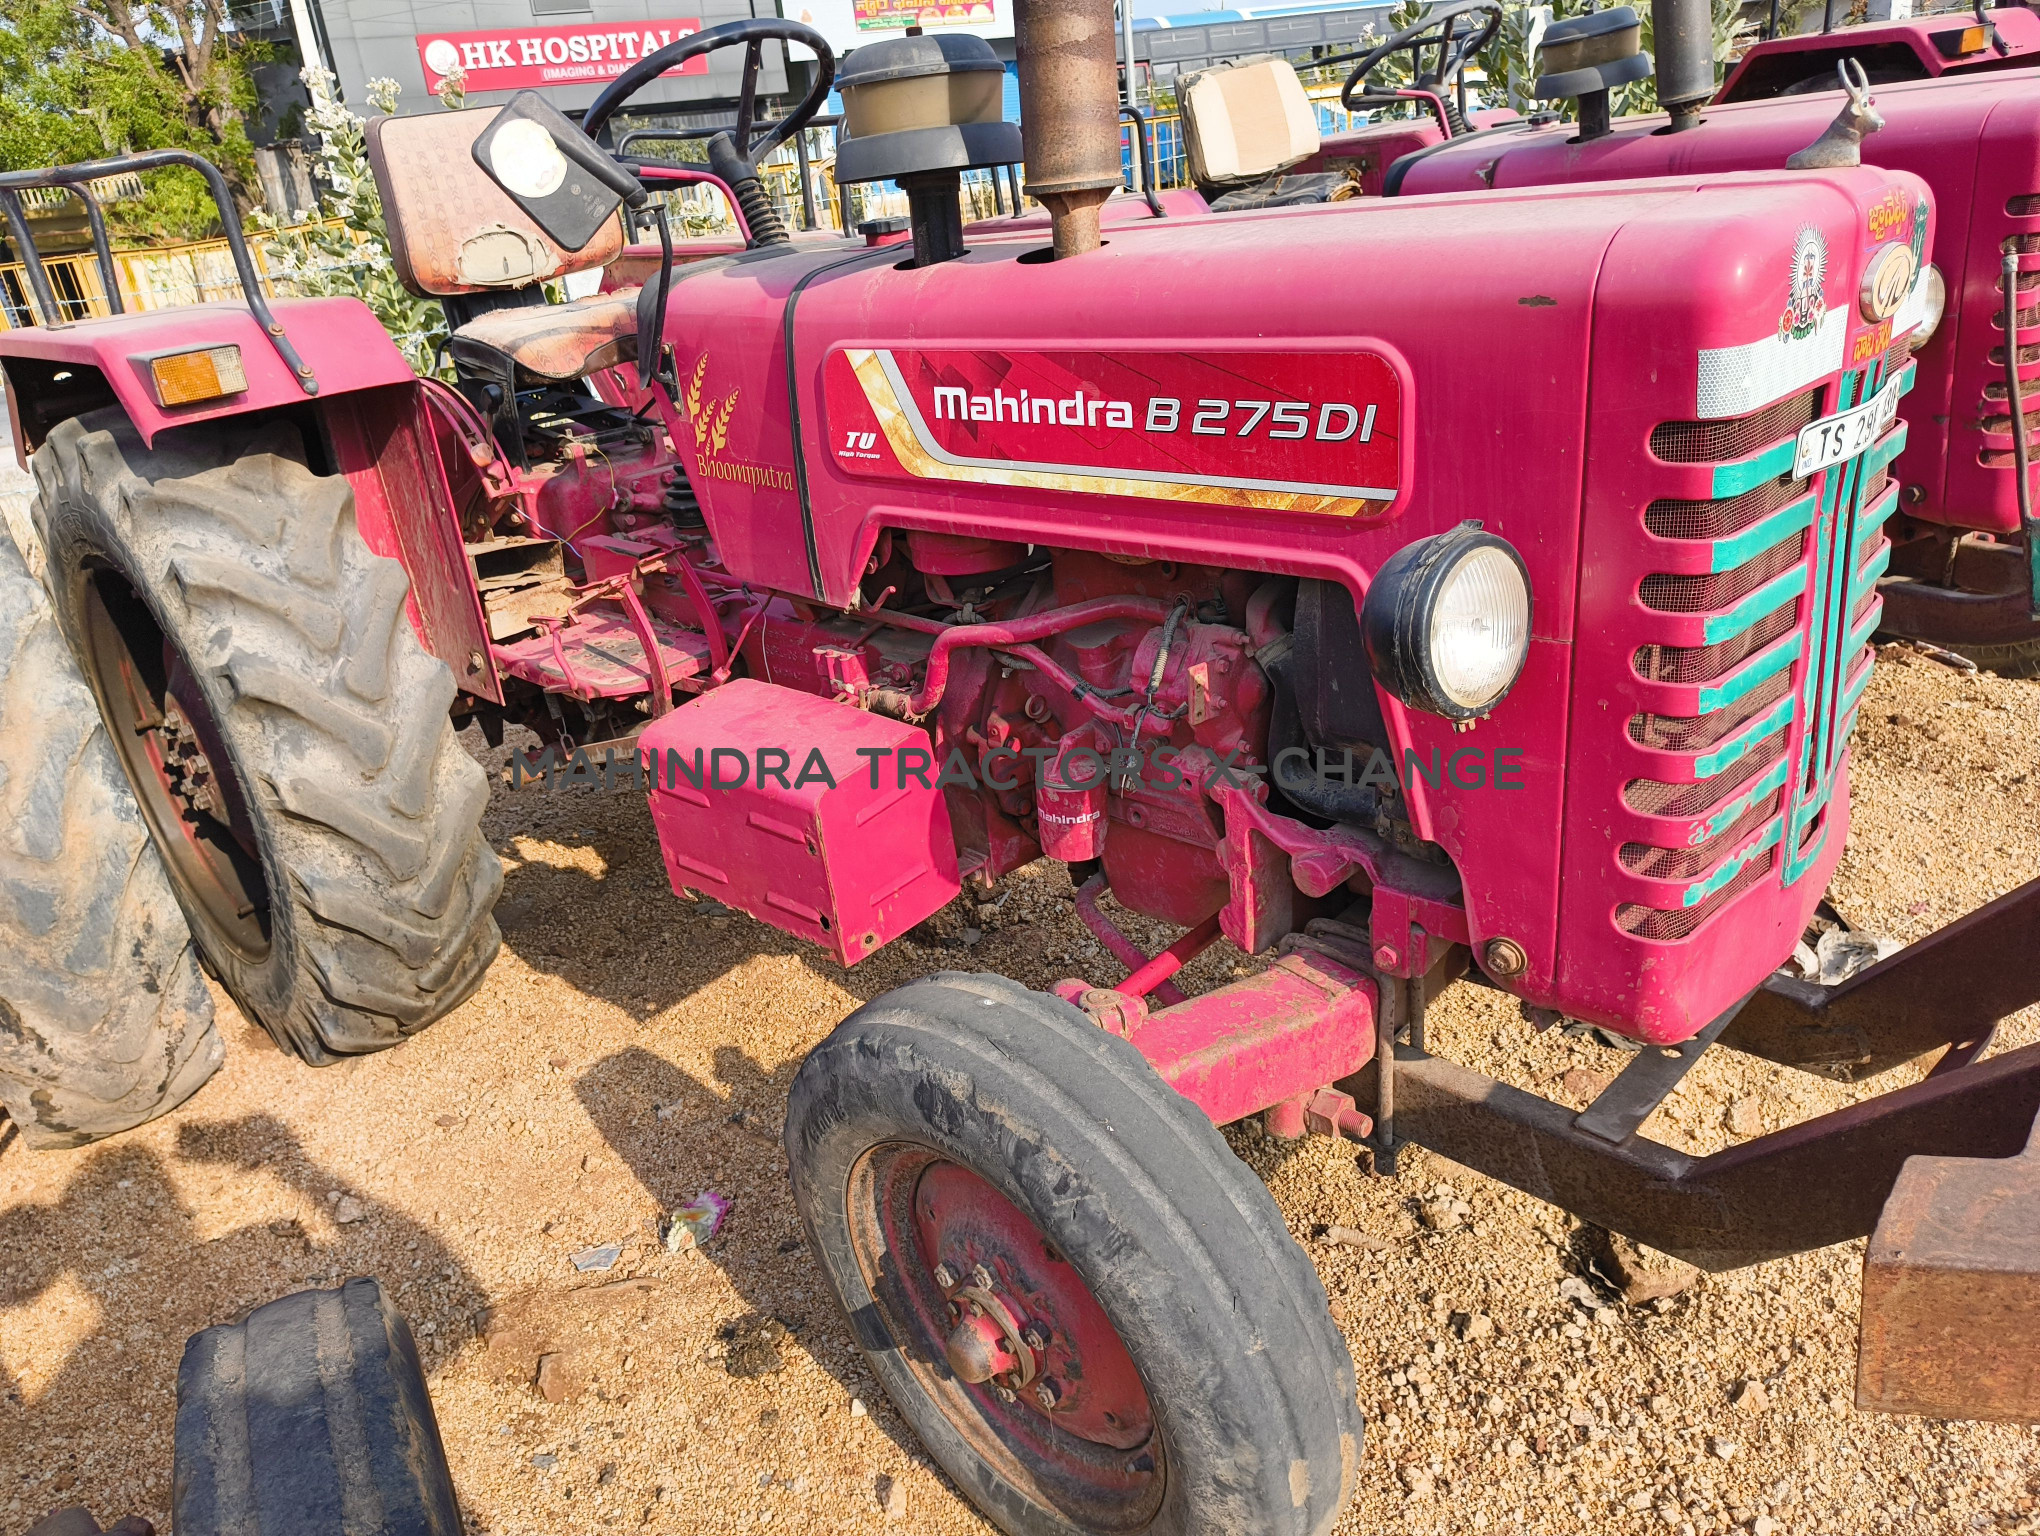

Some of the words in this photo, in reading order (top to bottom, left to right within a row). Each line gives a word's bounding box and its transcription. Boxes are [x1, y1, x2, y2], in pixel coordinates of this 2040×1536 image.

[460, 41, 516, 70] HK
[597, 64, 606, 75] &
[934, 386, 1133, 428] Mahindra
[1145, 397, 1182, 433] B
[846, 431, 877, 450] TU
[1820, 423, 1846, 461] TS
[695, 453, 794, 494] Bhoomiputra
